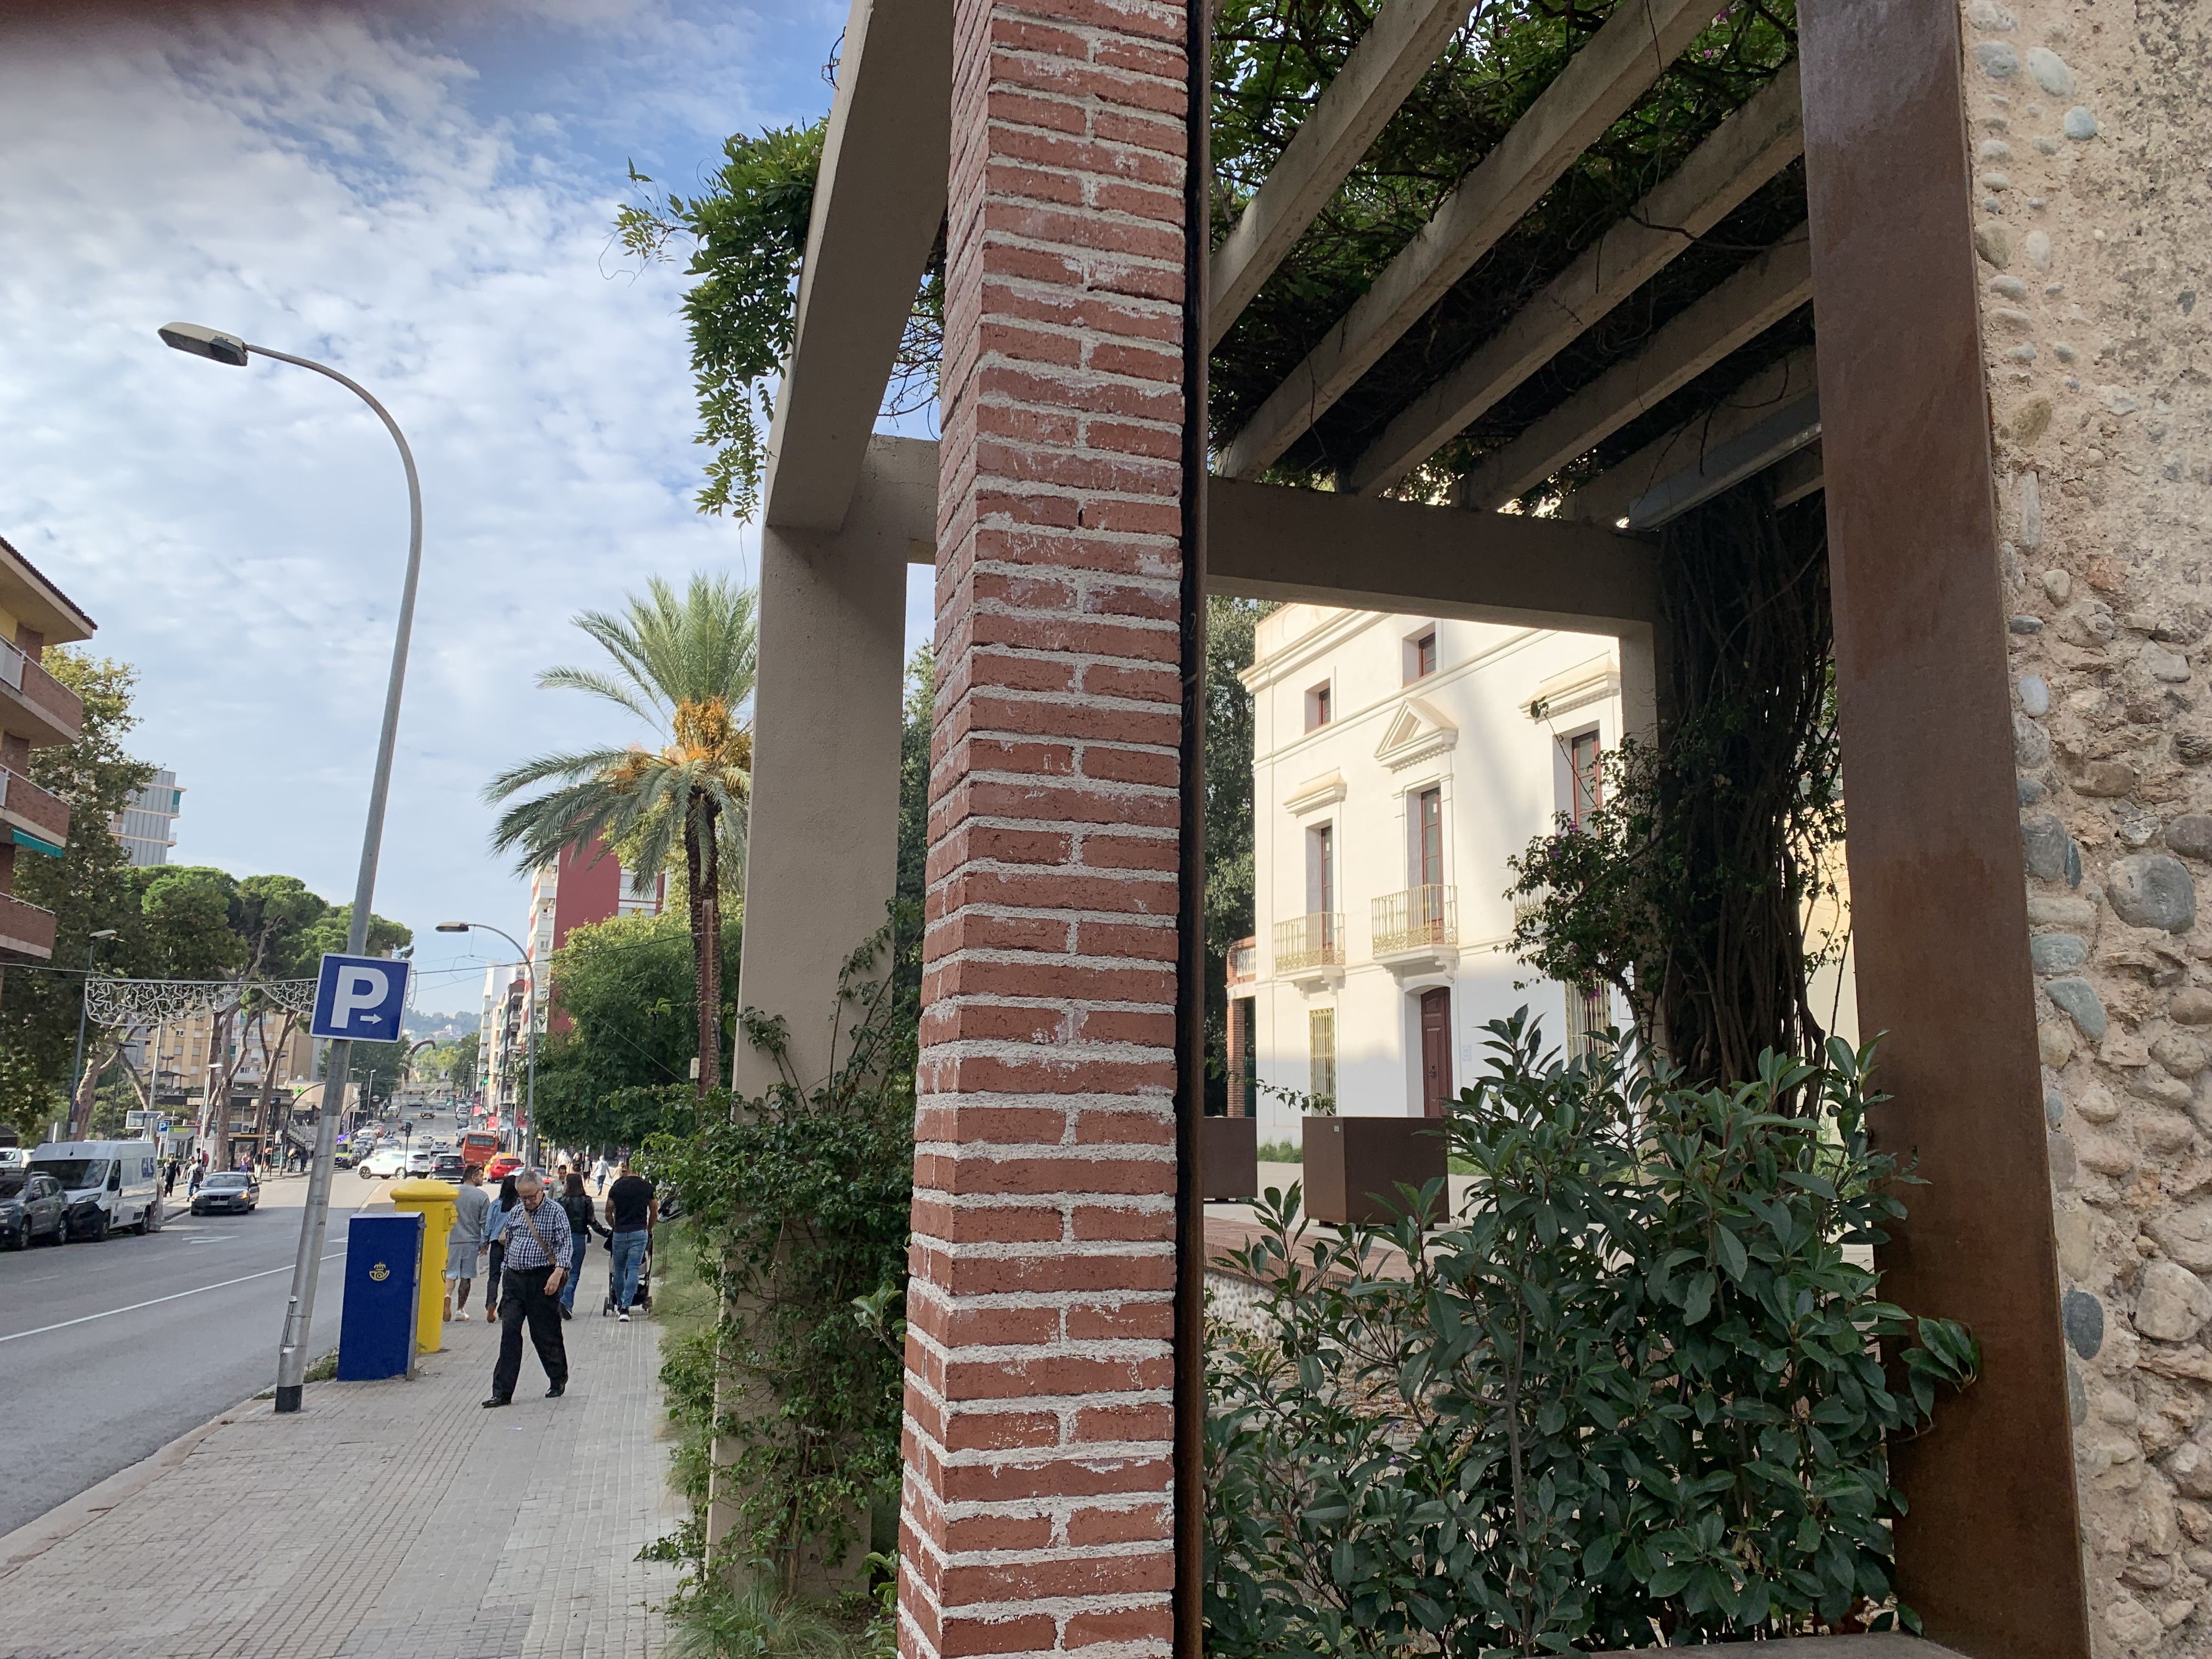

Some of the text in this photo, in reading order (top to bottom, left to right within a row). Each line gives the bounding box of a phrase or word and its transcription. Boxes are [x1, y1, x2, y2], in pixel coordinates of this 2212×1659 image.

[330, 965, 389, 1029] P
[159, 1122, 166, 1131] P
[142, 1157, 154, 1178] GLS
